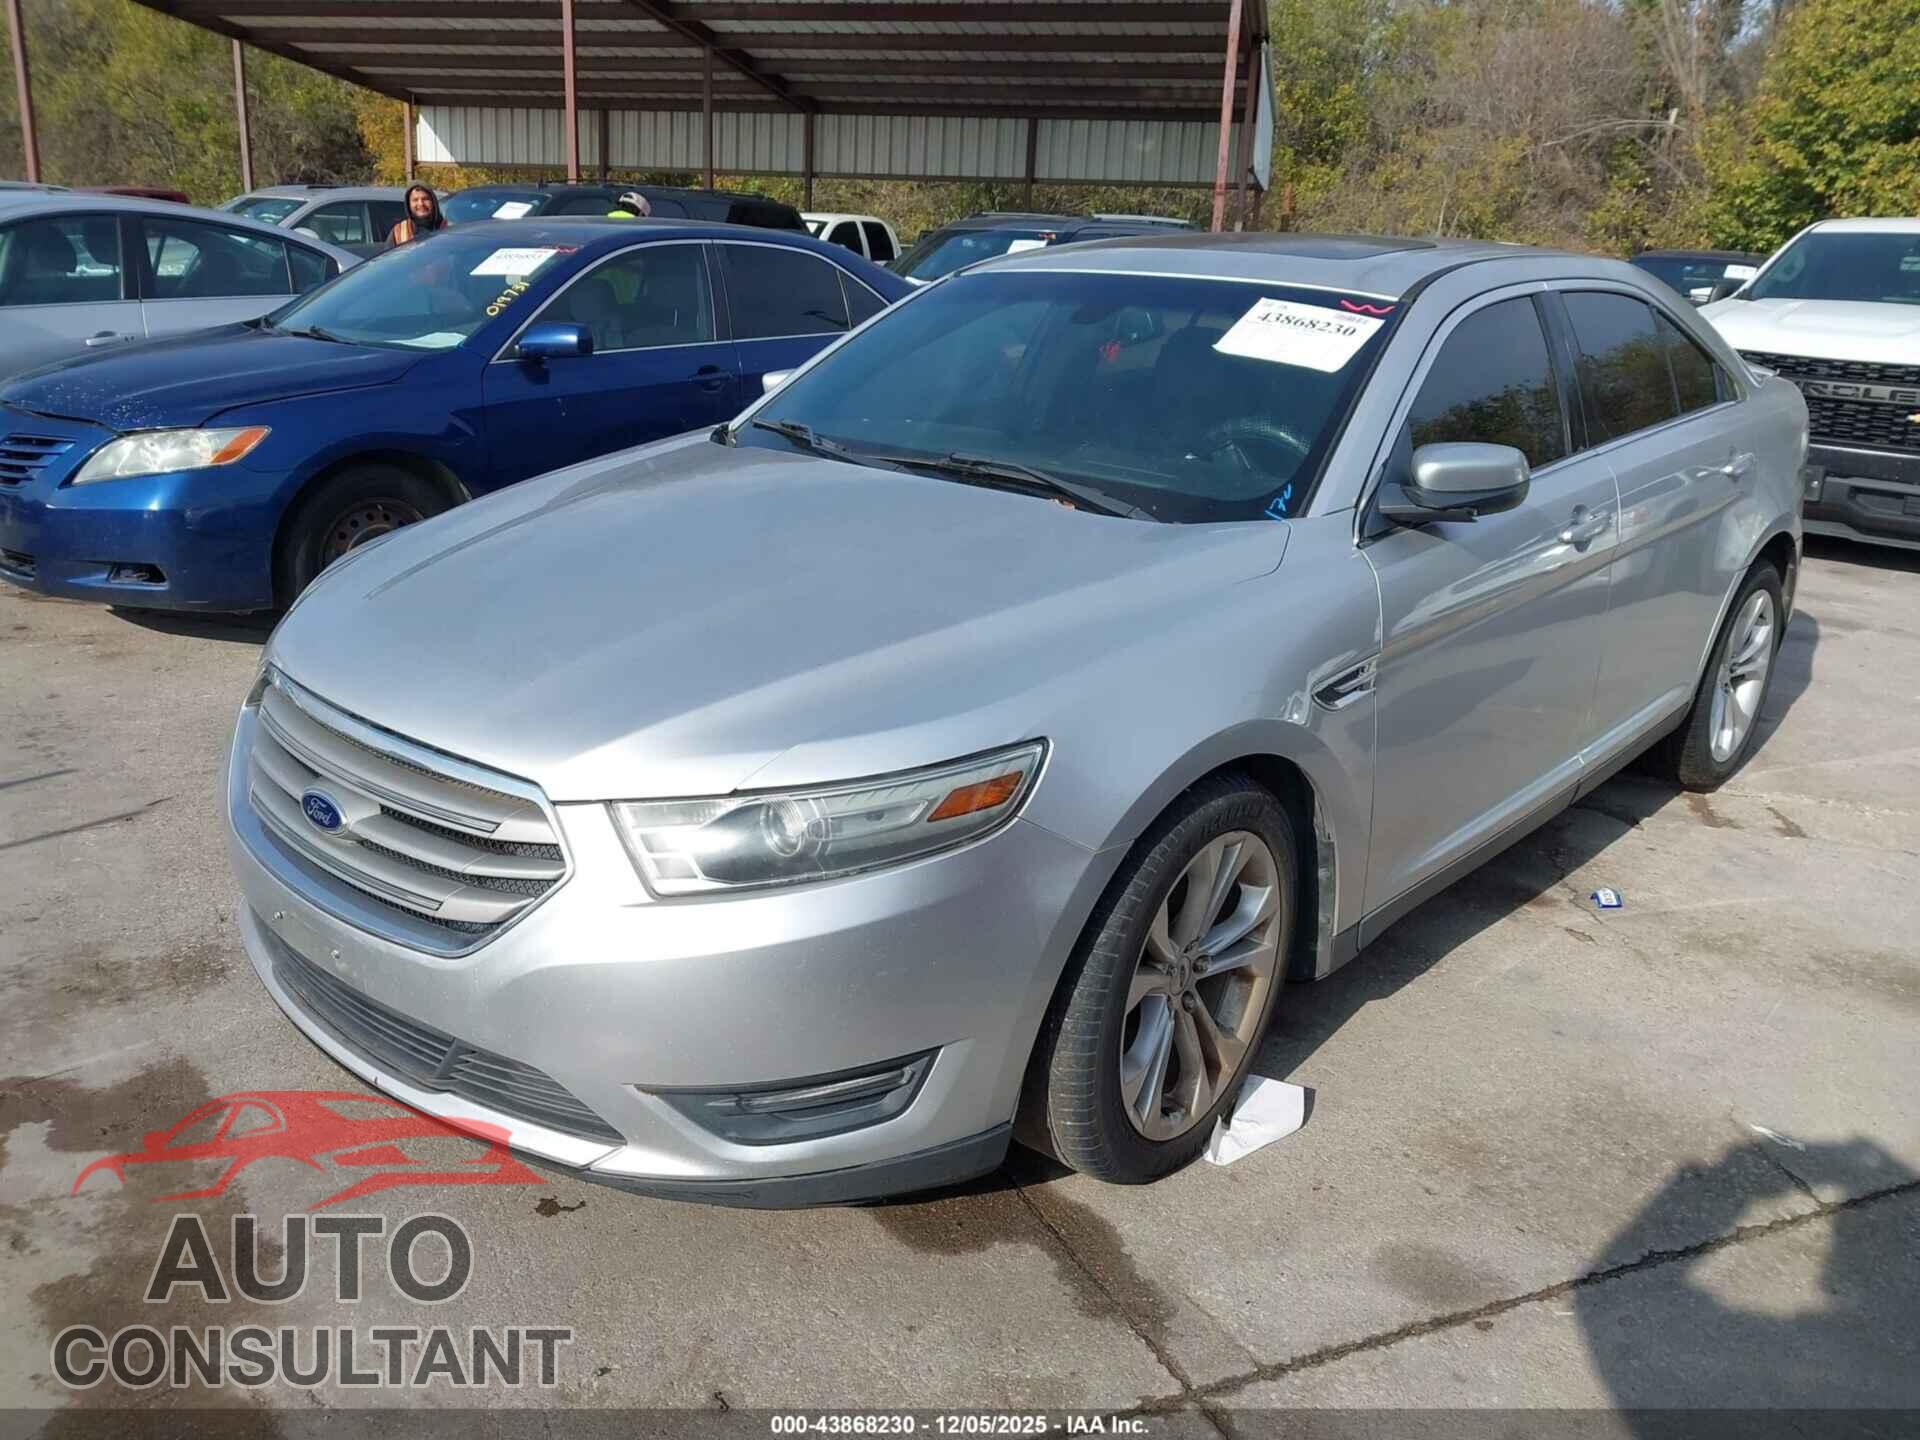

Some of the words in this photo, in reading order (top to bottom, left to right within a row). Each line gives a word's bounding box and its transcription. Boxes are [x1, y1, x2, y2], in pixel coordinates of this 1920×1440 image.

[1257, 311, 1357, 337] 43868230
[1803, 382, 1918, 403] ROLE
[307, 797, 334, 825] Ford
